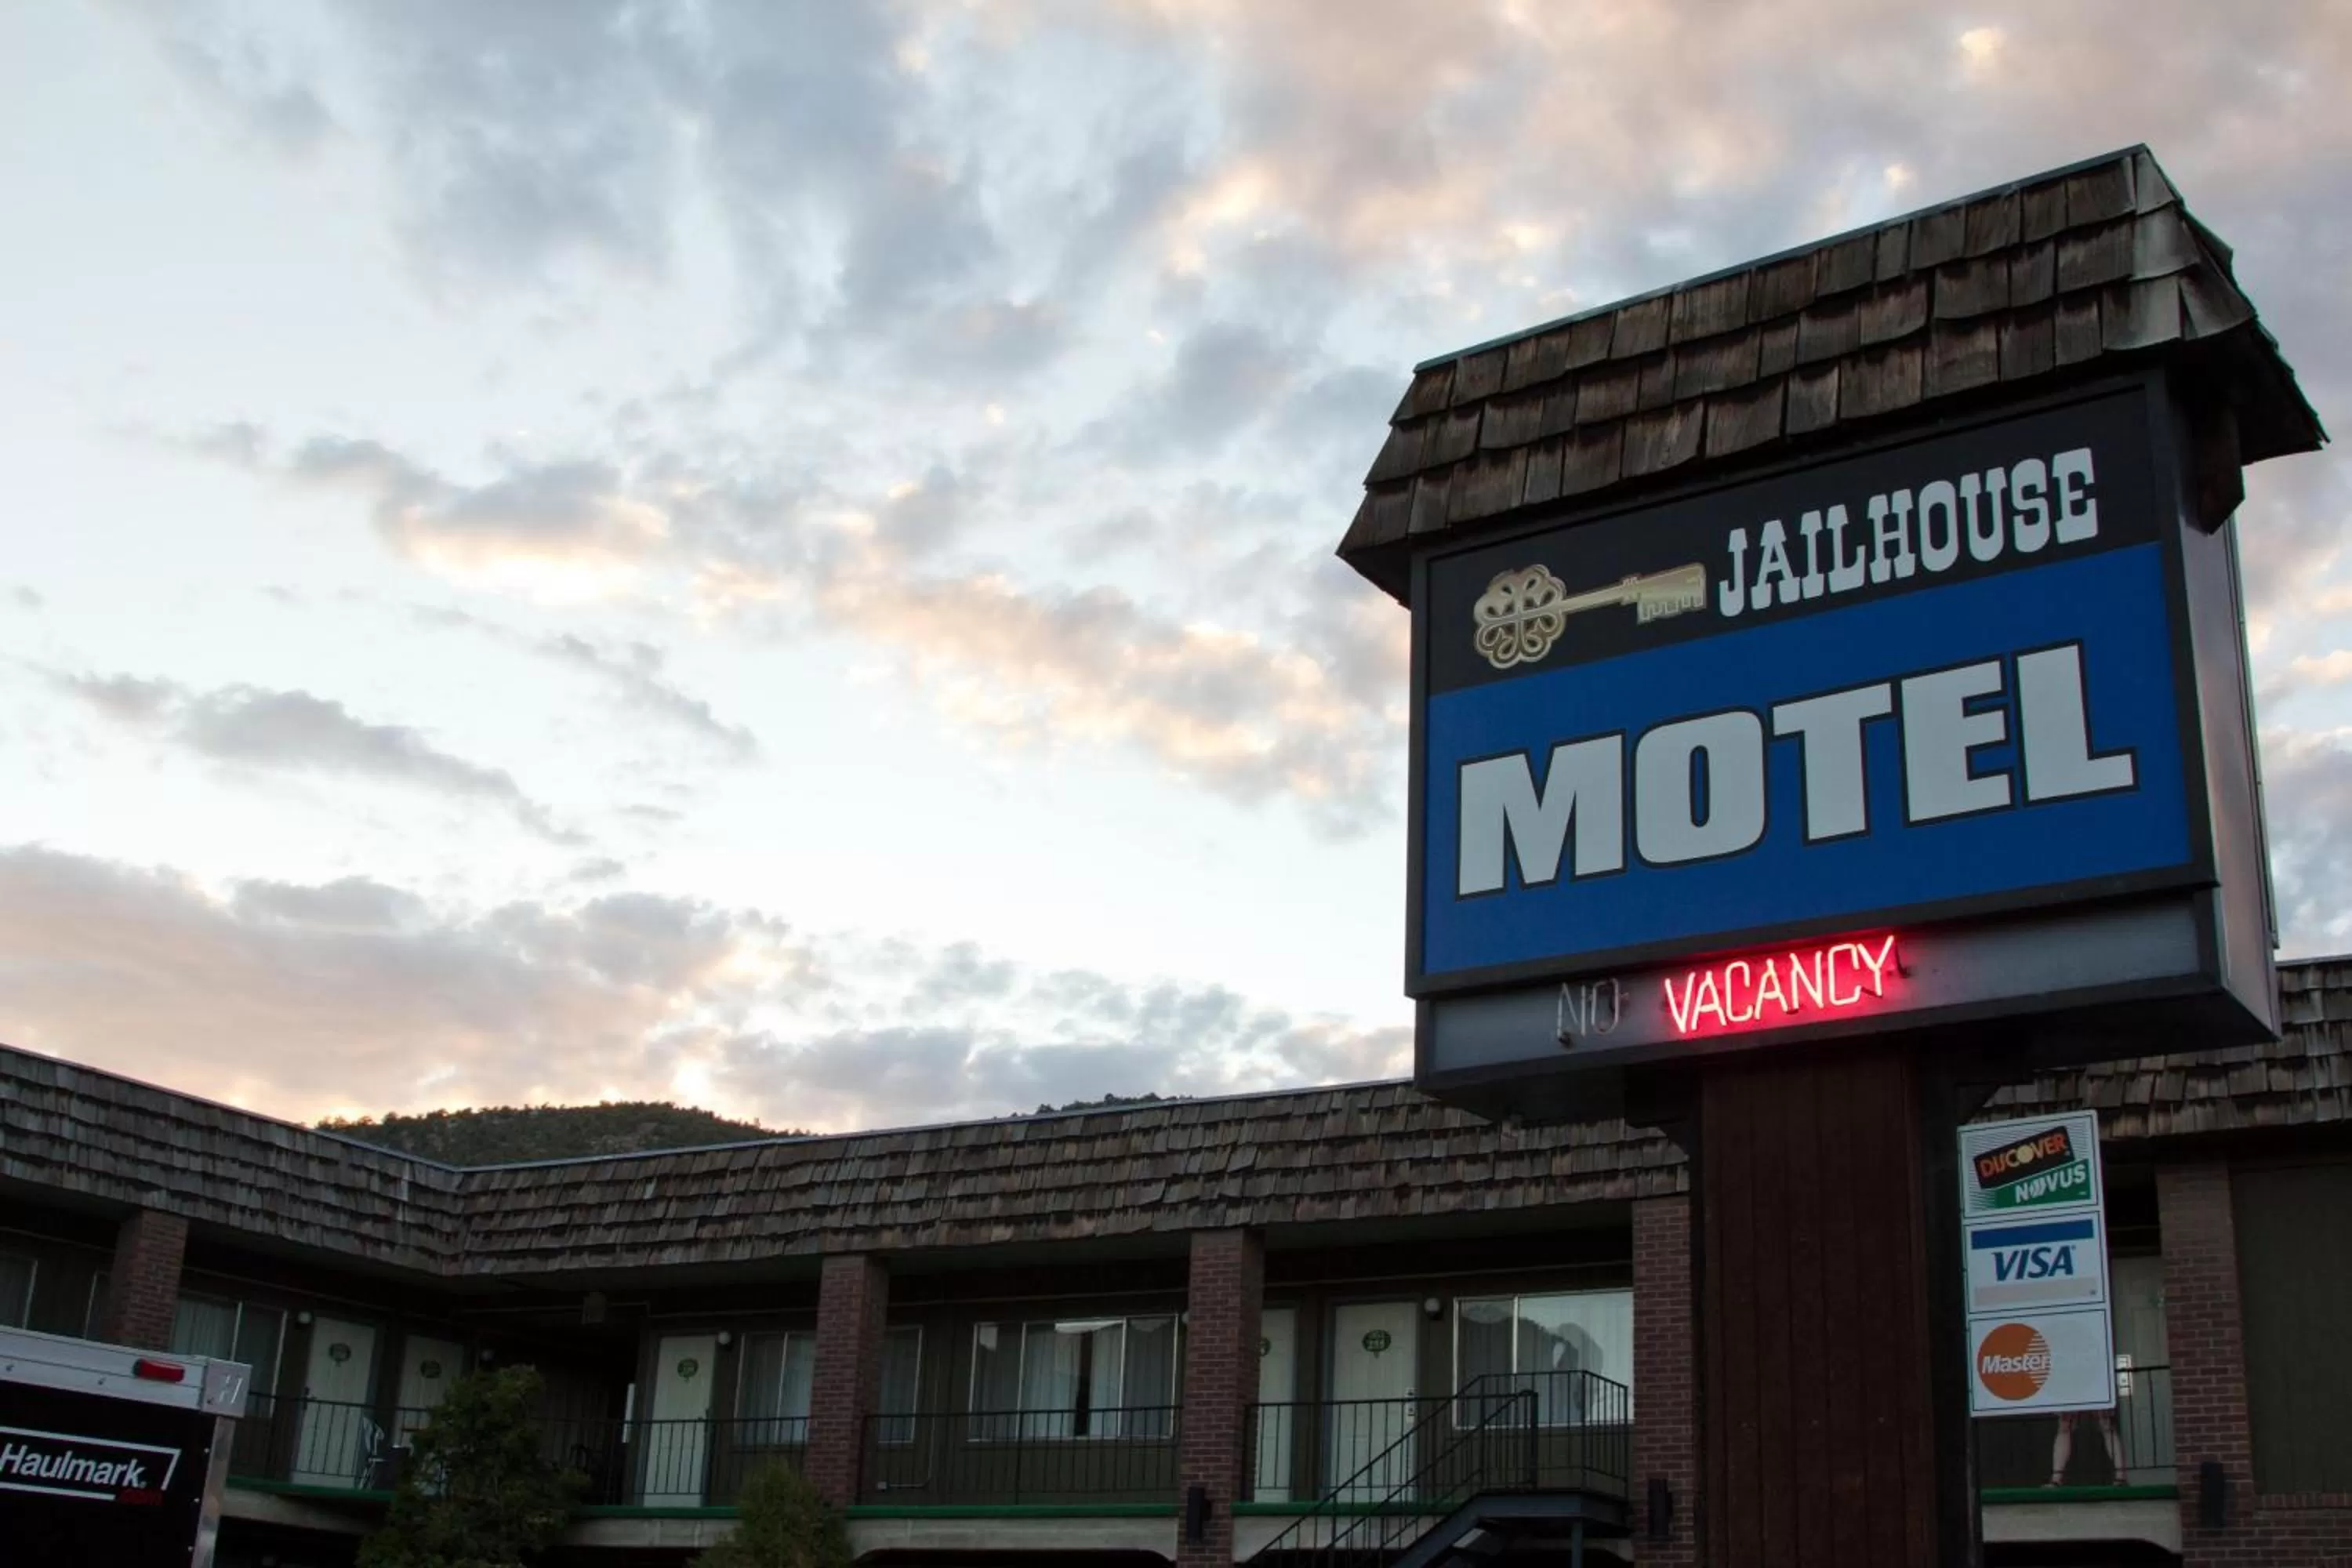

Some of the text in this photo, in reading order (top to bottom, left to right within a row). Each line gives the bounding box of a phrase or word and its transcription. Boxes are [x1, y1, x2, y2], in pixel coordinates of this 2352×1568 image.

[1719, 447, 2098, 617] JAILHOUSE
[1458, 641, 2136, 897] MOTEL
[1556, 935, 1896, 1037] NO VACANCY
[2015, 1163, 2086, 1204] NOVUS
[1992, 1245, 2074, 1281] VISA
[1982, 1353, 2050, 1374] Master
[0, 1443, 146, 1487] Haulmark
